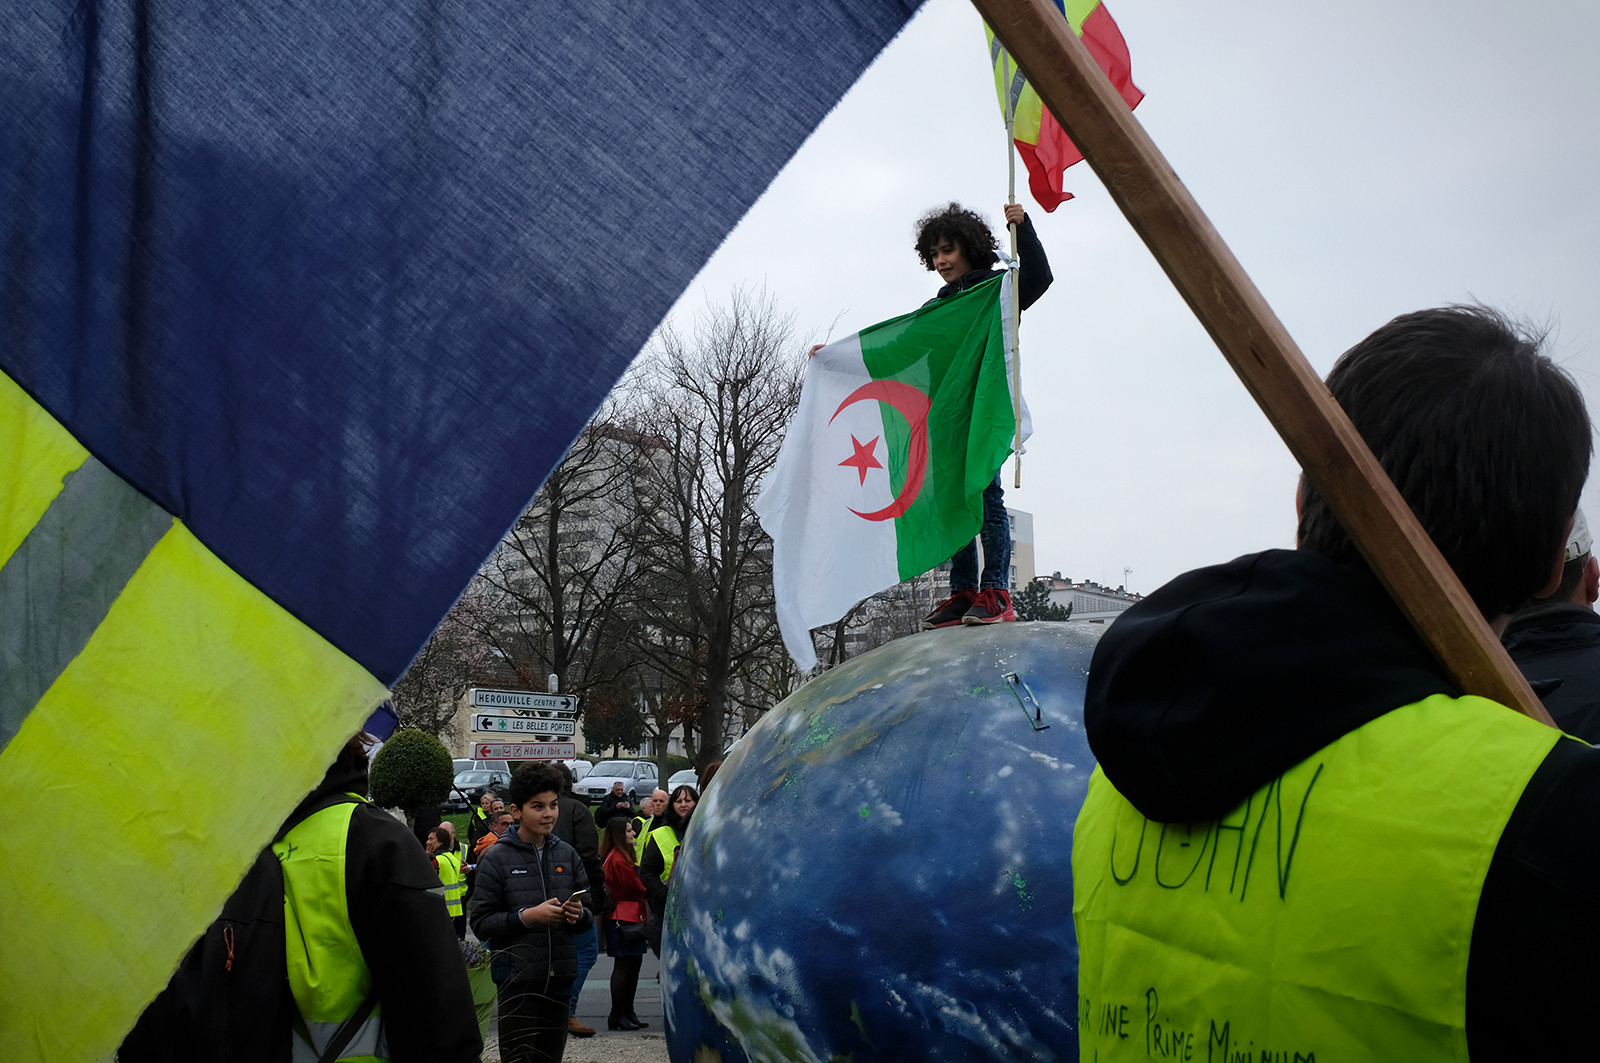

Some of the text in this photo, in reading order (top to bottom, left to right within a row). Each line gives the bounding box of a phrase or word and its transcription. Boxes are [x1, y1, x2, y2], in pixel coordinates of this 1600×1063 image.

[479, 694, 557, 707] HEROUVILLE CENTRE
[512, 721, 573, 732] LES BELLES PORTES
[524, 746, 561, 755] Hôtel Ibis
